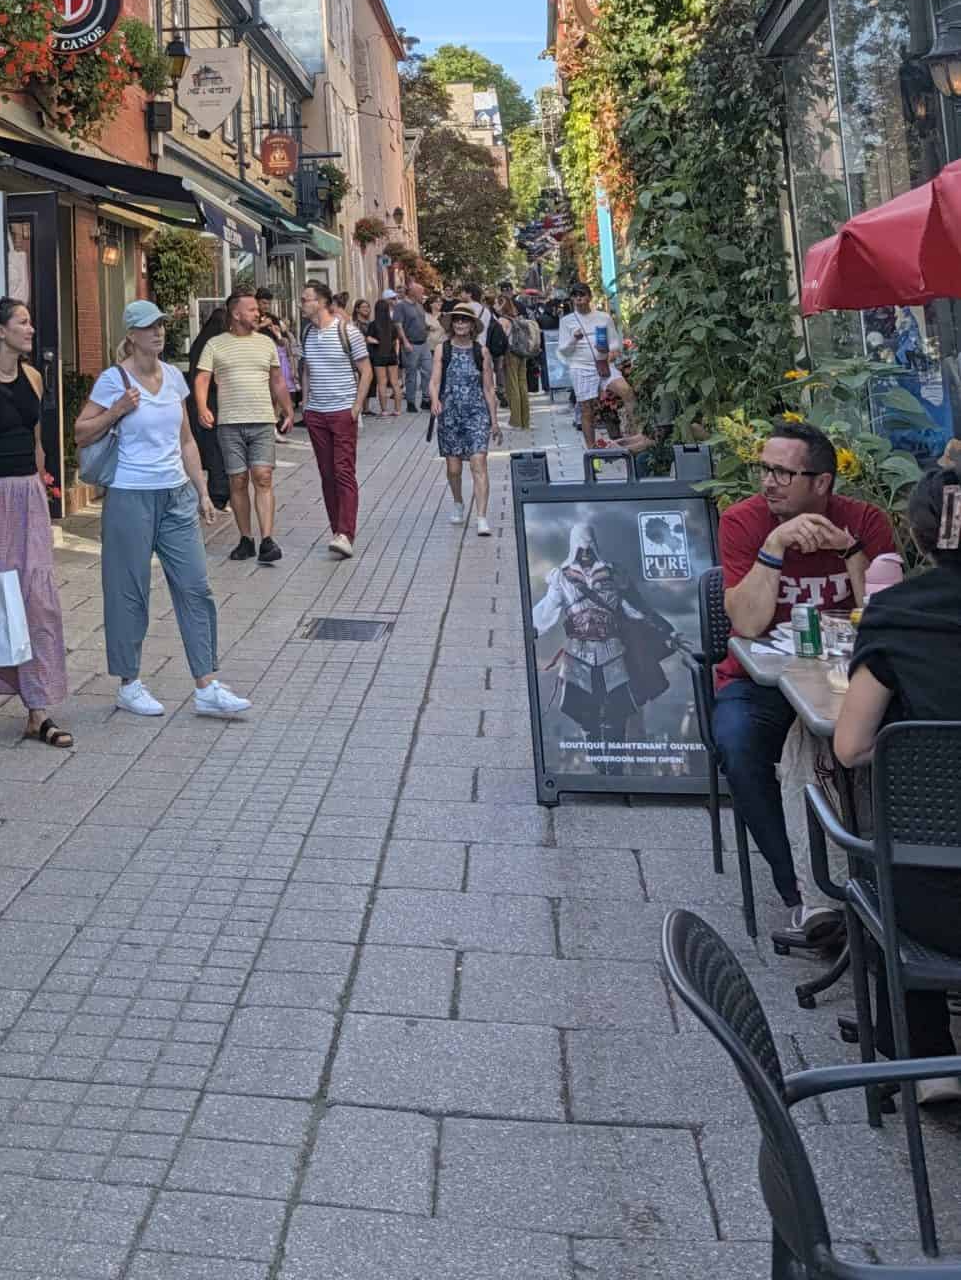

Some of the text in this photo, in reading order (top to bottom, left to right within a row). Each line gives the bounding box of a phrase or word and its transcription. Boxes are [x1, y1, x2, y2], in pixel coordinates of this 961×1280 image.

[61, 25, 105, 50] CANOE
[645, 556, 687, 570] PURE
[559, 742, 605, 751] BOUTIQUE
[608, 742, 667, 751] MAINTENANT
[585, 755, 635, 763] SHOWROOM
